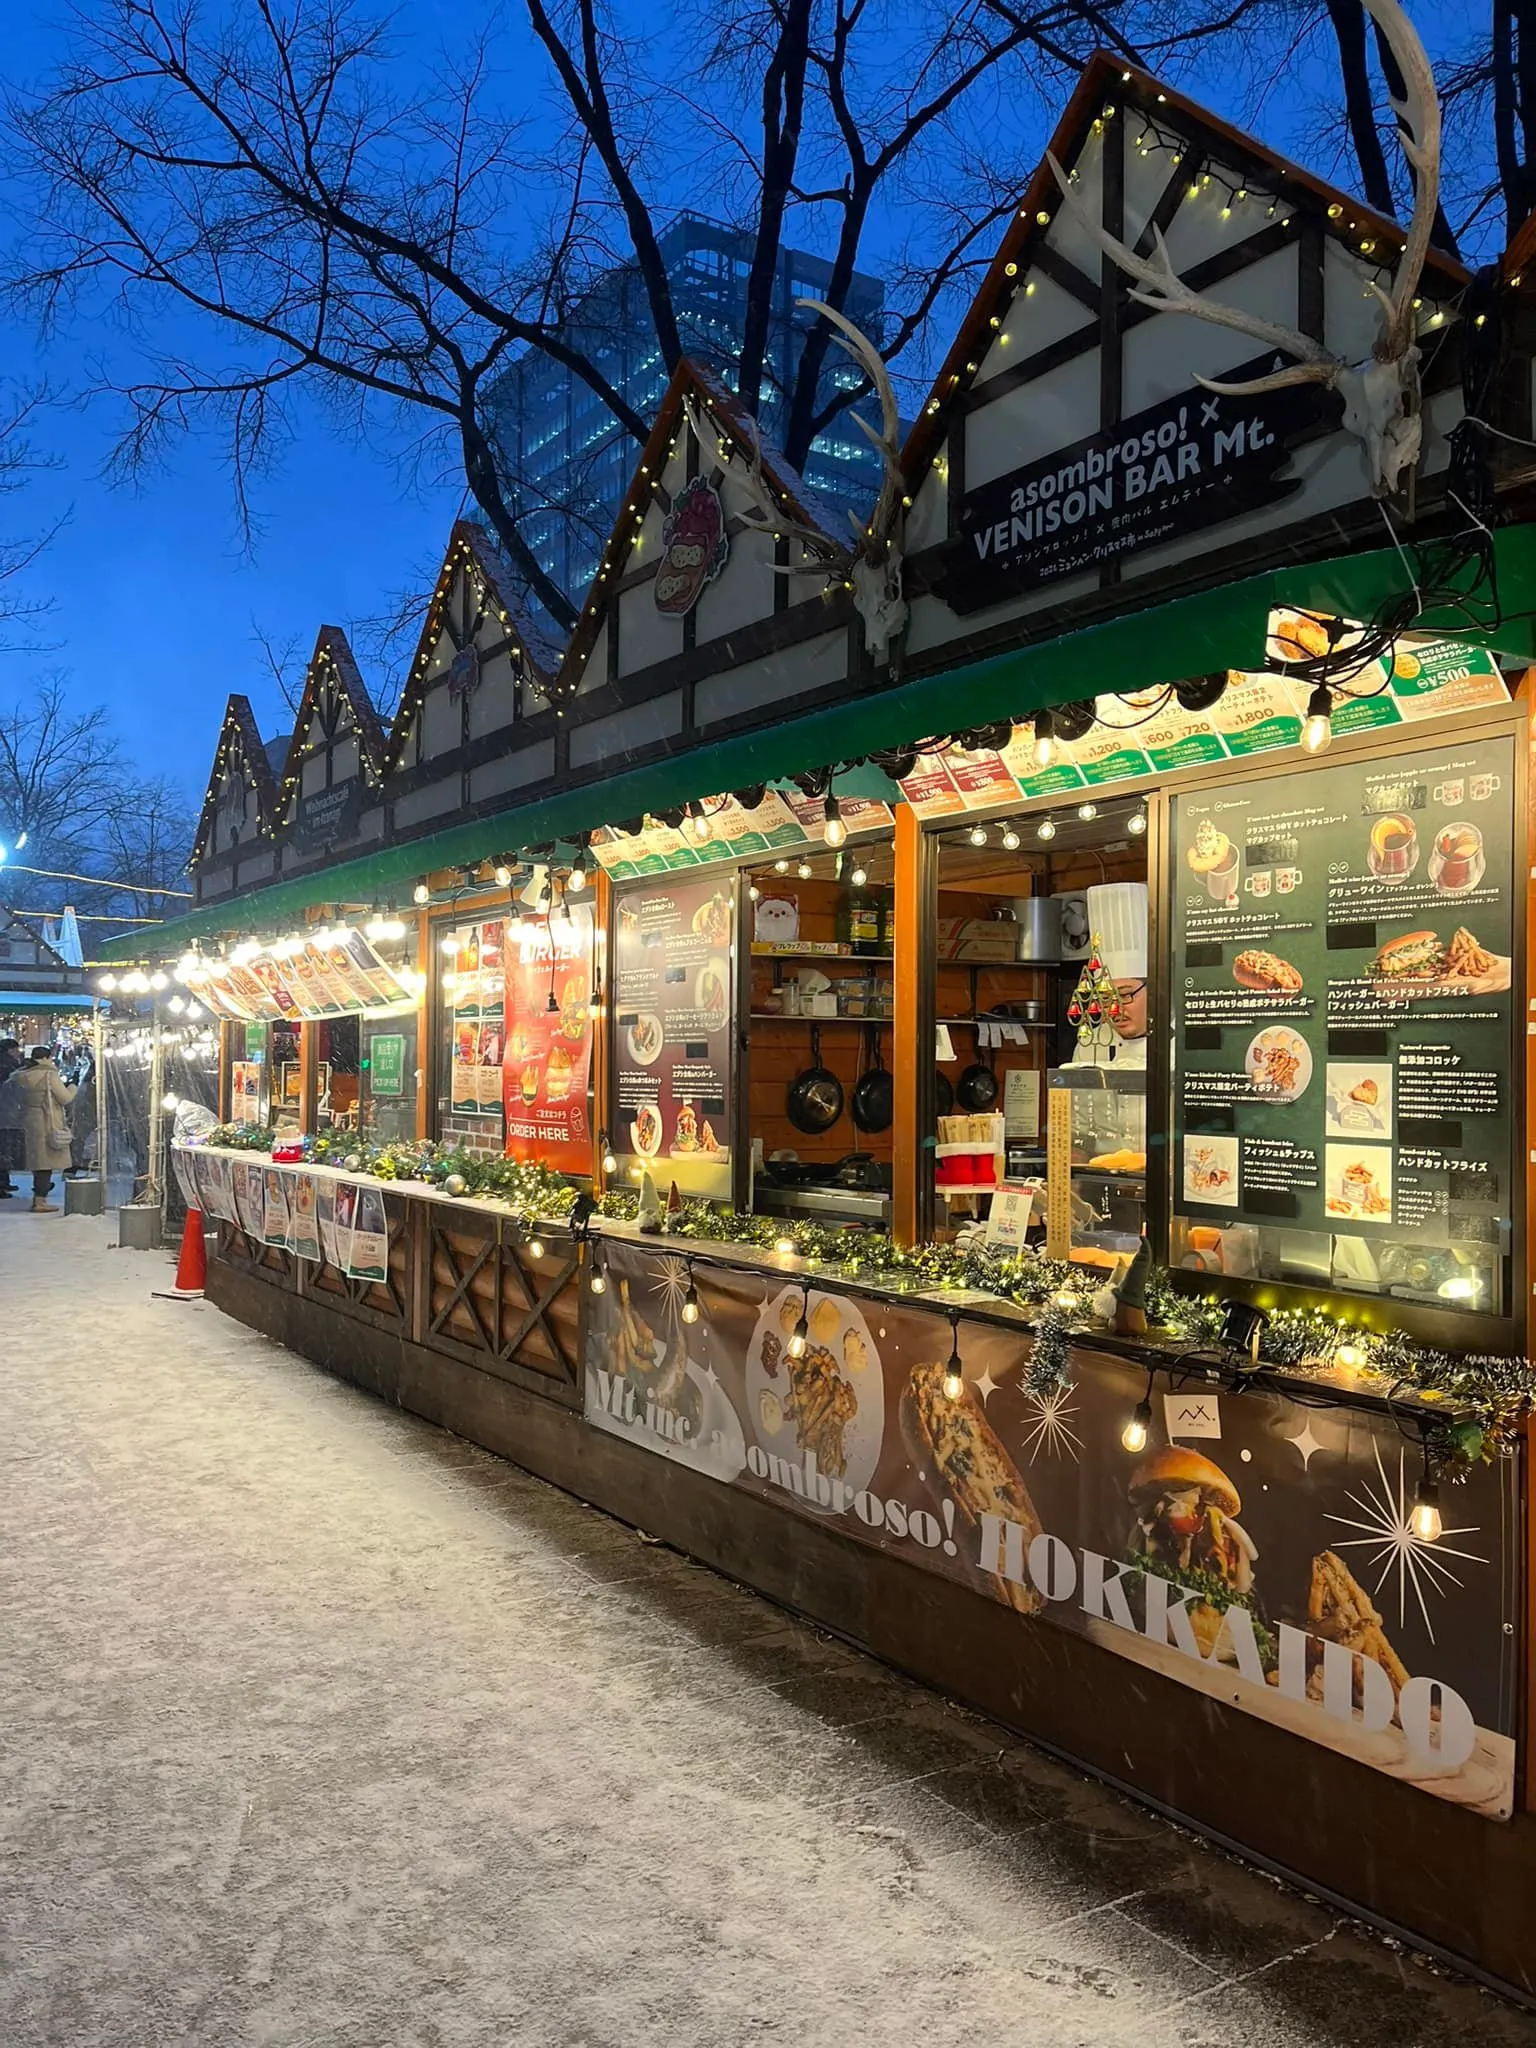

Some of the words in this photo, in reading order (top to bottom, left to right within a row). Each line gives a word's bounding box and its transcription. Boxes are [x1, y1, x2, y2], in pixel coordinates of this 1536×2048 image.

[1010, 406, 1188, 513] asombroso!
[973, 477, 1113, 561] VENISON
[1125, 442, 1201, 501] BAR
[1213, 415, 1275, 467] Mt.
[1427, 666, 1470, 687] ¥500
[1328, 882, 1385, 898] グリューワイン
[1399, 1055, 1461, 1066] 無添加コロッケ
[510, 1123, 537, 1139] ORDER
[539, 1127, 570, 1141] HERE
[1244, 1146, 1315, 1160] フィッシュ&チップス
[1398, 1157, 1488, 1172] ハンドカットフライズ
[711, 1430, 958, 1557] aombroso!
[976, 1511, 1476, 1769] HOKKAIDO
